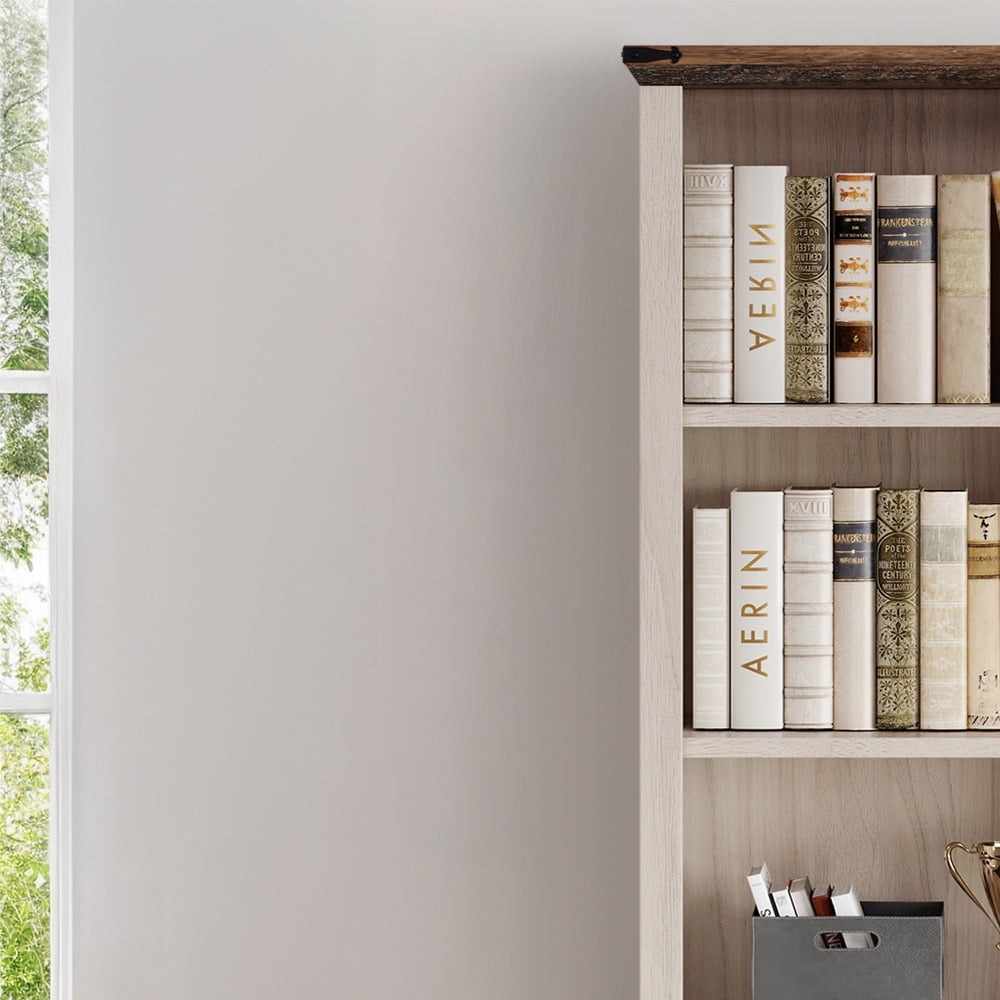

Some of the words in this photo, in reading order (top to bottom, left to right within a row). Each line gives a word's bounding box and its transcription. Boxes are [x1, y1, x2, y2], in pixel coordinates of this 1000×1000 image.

[787, 501, 827, 515] XVIII
[884, 544, 911, 553] POETS
[882, 570, 913, 580] CENTURY
[741, 550, 769, 677] AERIN
